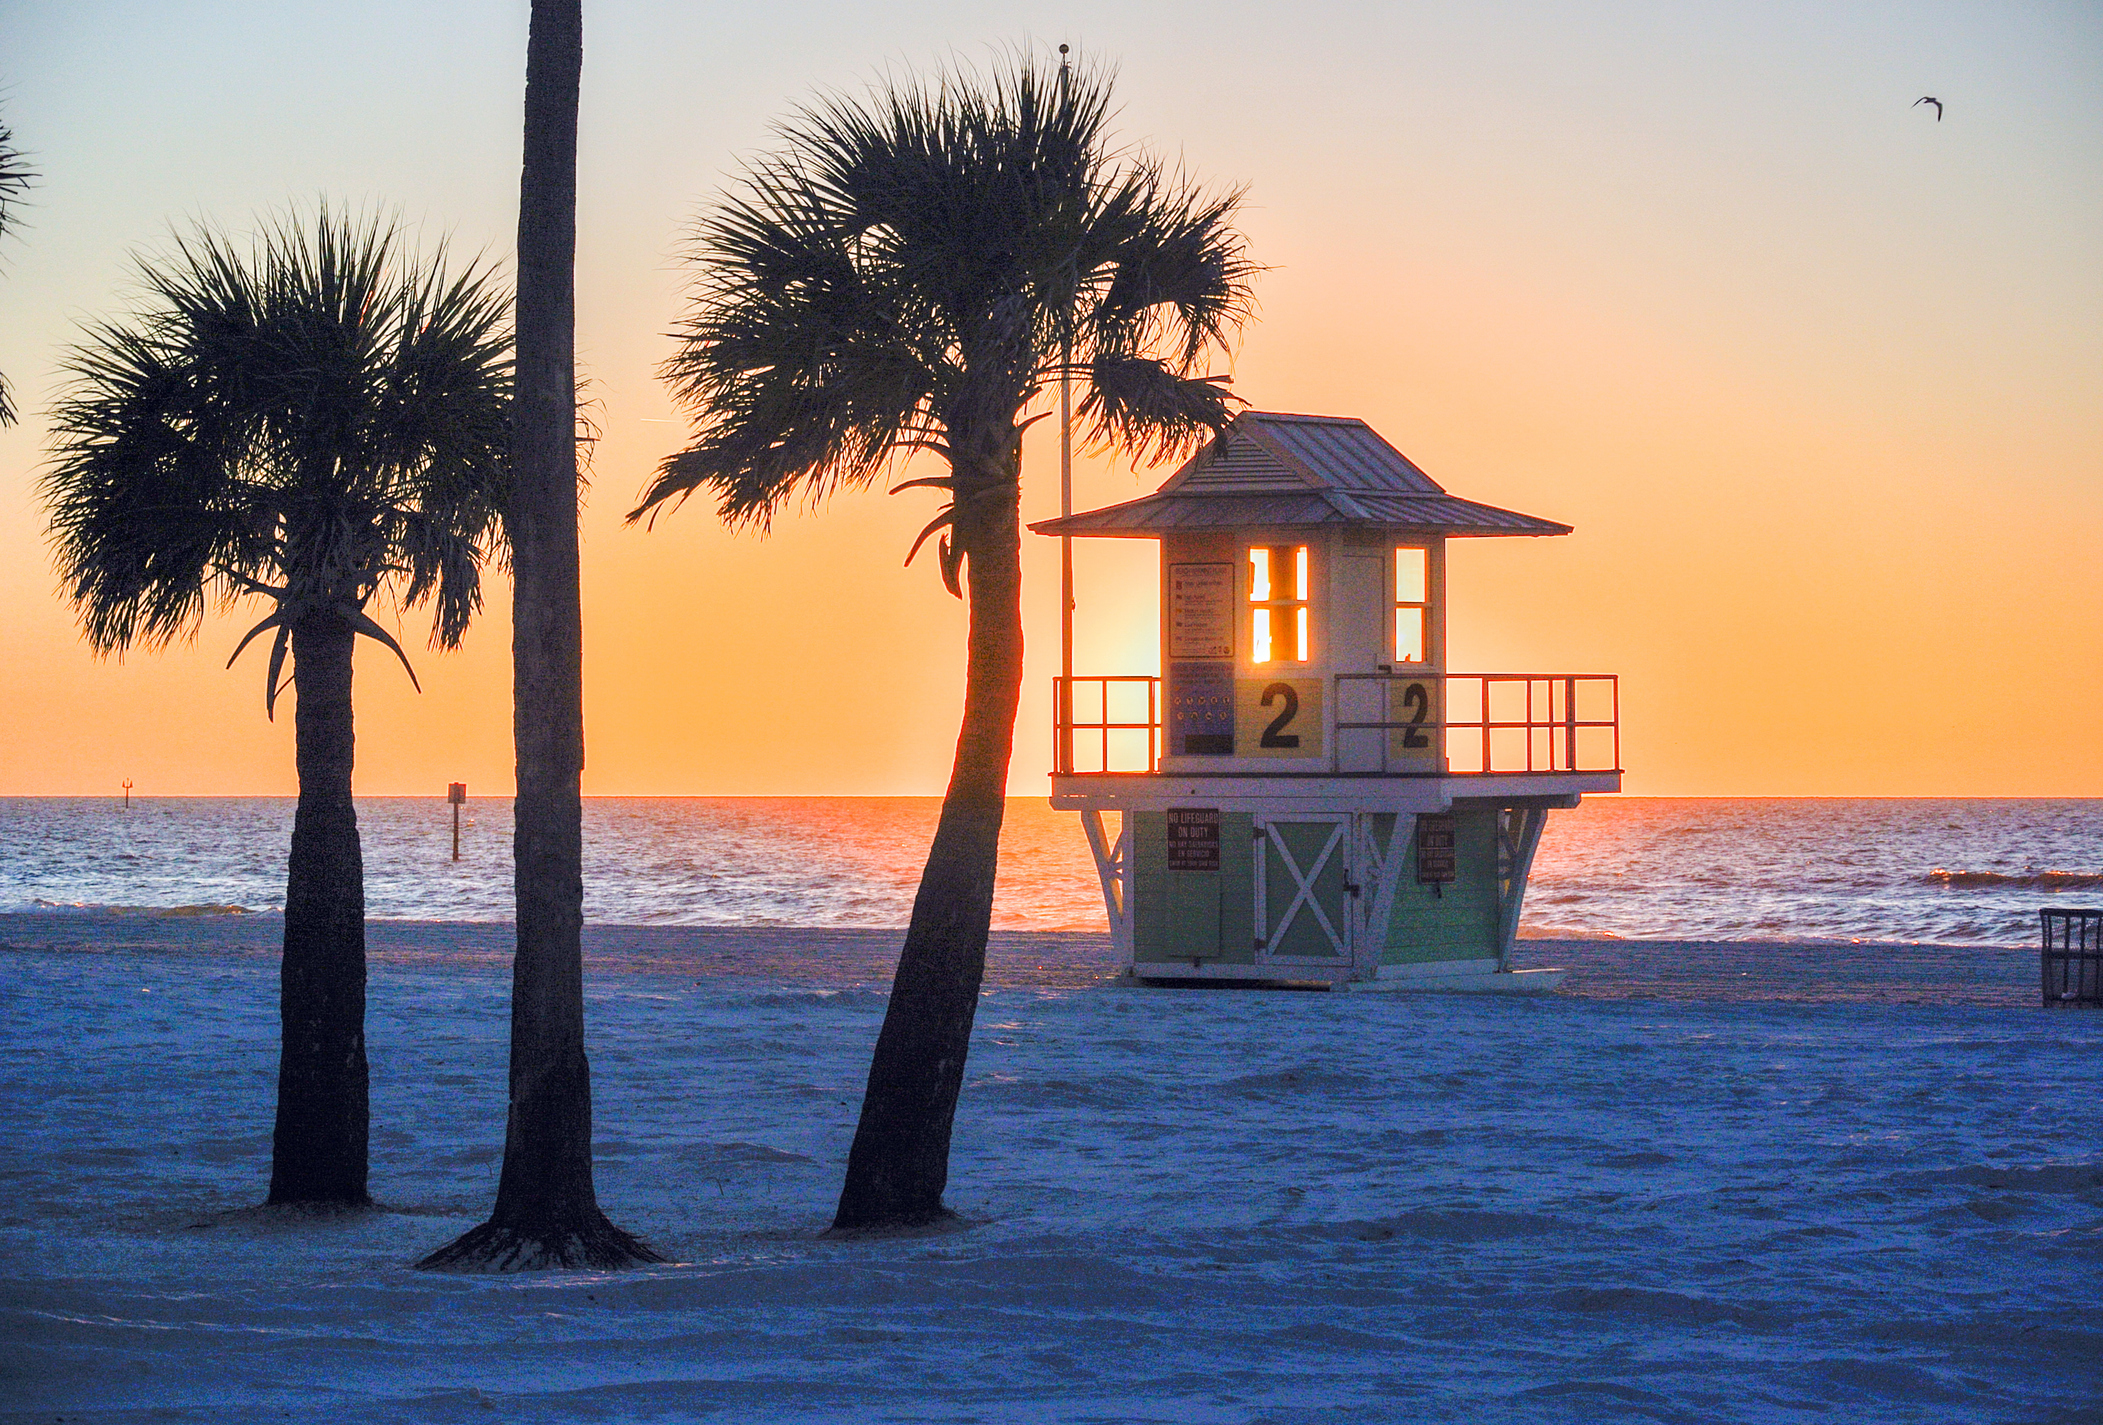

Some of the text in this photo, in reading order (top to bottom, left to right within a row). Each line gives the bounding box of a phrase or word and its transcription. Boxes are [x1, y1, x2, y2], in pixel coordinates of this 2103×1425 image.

[1260, 682, 1299, 748] 2
[1404, 683, 1428, 748] 2
[1168, 812, 1219, 824] NO LIFEGUARD
[1178, 826, 1209, 838] ON DUTY
